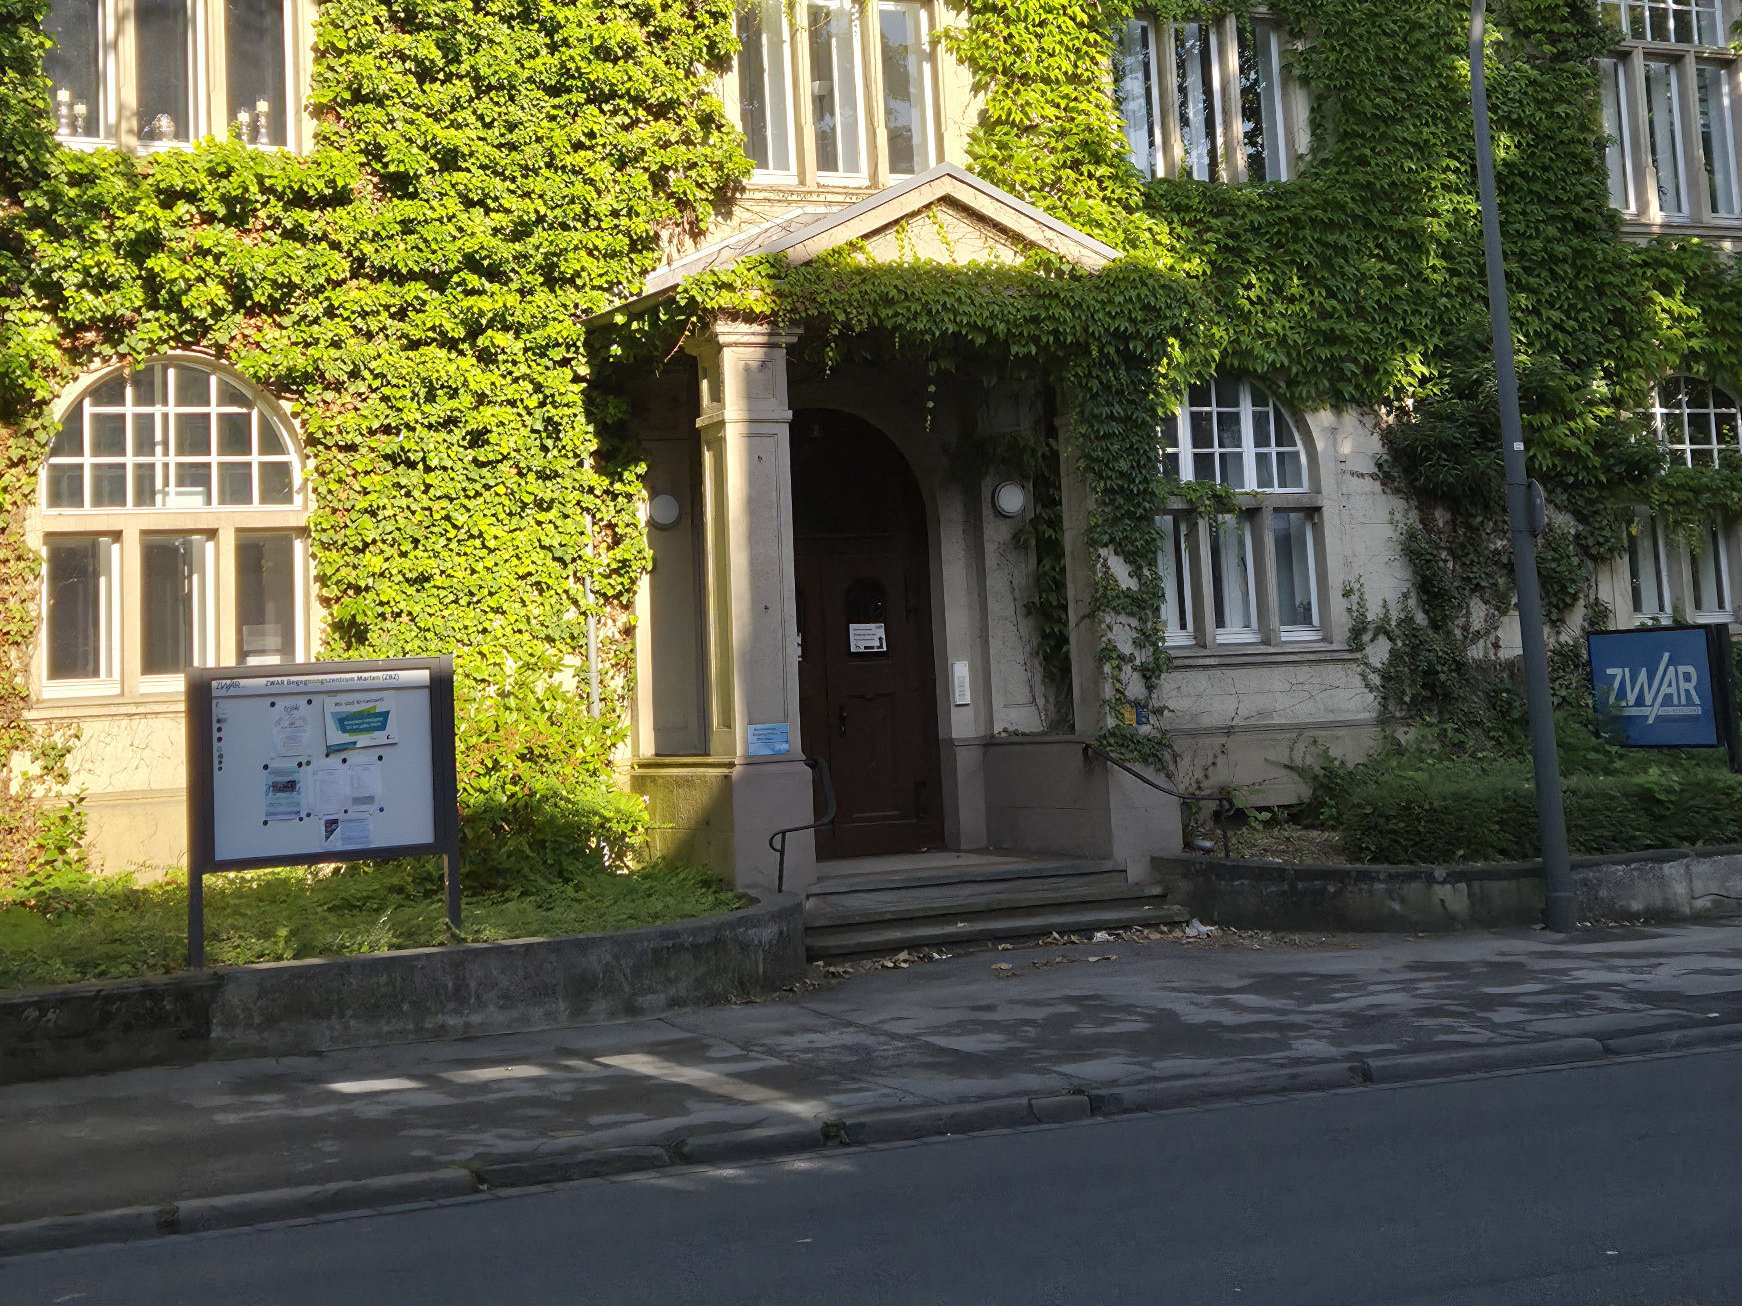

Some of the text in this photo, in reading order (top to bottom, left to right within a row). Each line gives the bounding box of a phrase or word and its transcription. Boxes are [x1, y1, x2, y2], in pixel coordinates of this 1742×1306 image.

[216, 679, 241, 693] ZWAR
[265, 679, 284, 687] ZWAR
[286, 676, 355, 686] Begegnungszentrum
[1606, 652, 1701, 724] ZWAR
